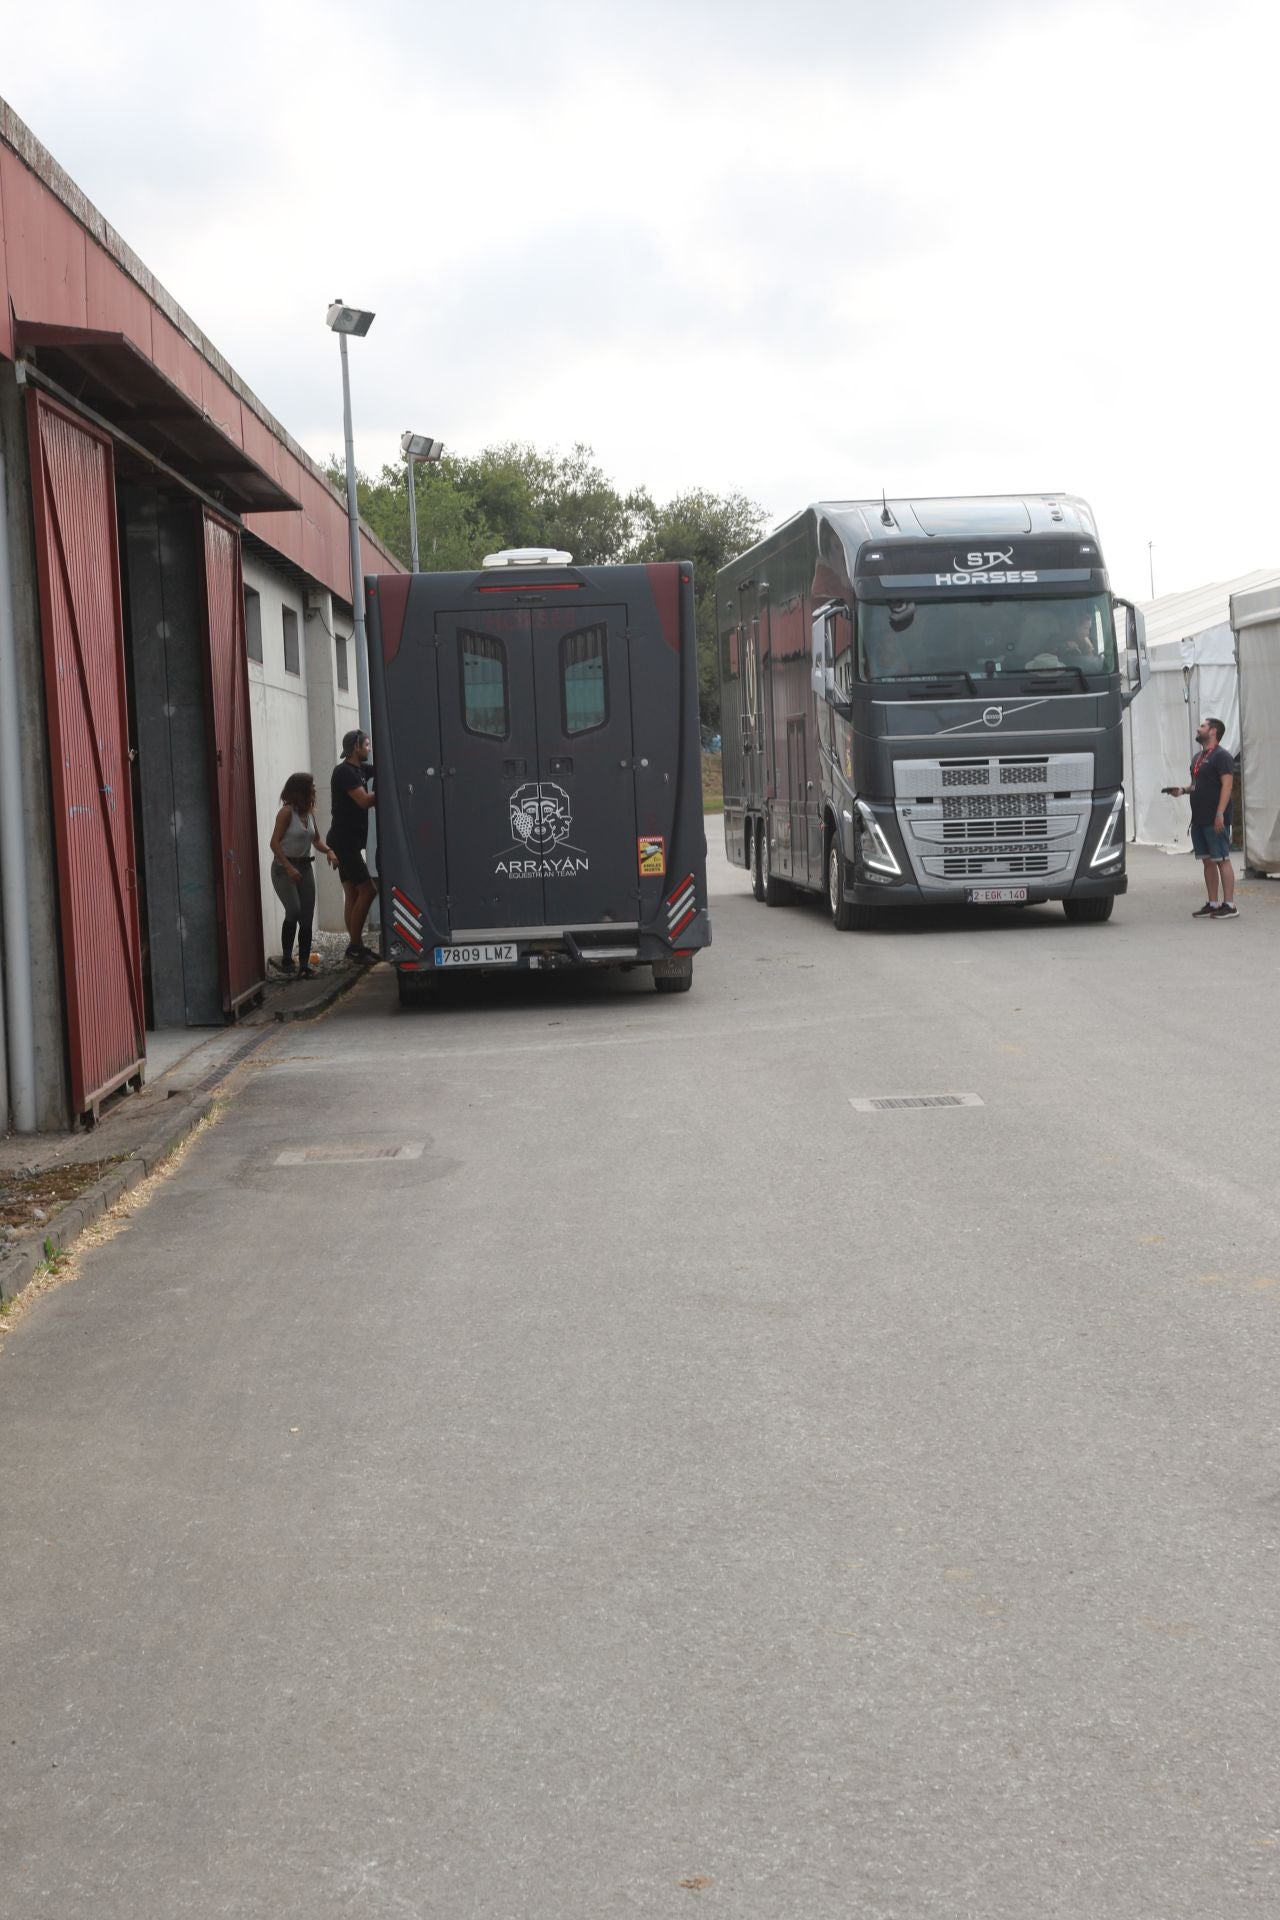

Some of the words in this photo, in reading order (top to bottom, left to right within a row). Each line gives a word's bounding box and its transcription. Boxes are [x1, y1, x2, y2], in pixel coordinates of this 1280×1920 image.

[967, 551, 1014, 566] STX
[935, 571, 1038, 586] HORSES
[494, 856, 589, 874] ARRAYÁN
[508, 870, 555, 880] EQUESTRIAN
[557, 870, 577, 878] TEAM
[443, 948, 480, 963] 7809
[485, 946, 513, 961] LMZ
